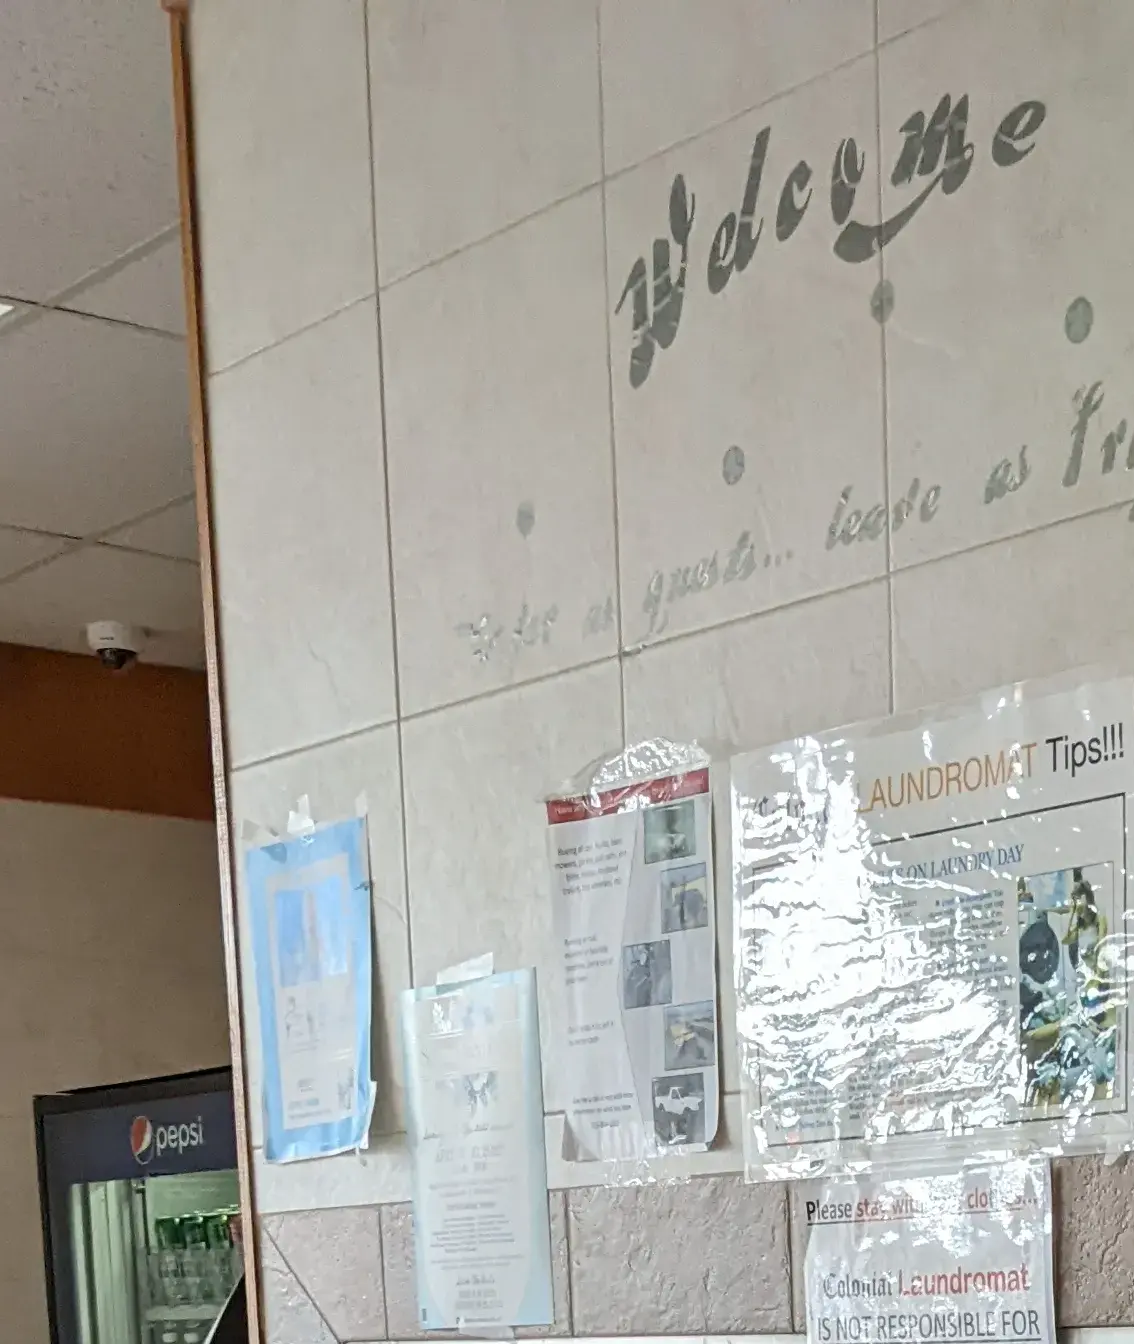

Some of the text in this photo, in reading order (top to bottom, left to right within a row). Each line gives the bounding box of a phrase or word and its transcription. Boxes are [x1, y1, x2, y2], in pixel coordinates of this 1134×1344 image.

[614, 93, 1046, 389] Welcome
[856, 722, 1125, 813] LAUNDROMAT Tips!!!
[998, 843, 1026, 866] DAY
[155, 1115, 204, 1157] pepsi
[806, 1199, 852, 1221] Please
[823, 1263, 1032, 1300] Colonial Laundromat
[817, 1309, 1040, 1342] IS NOT RESPONSIBLE FOR
